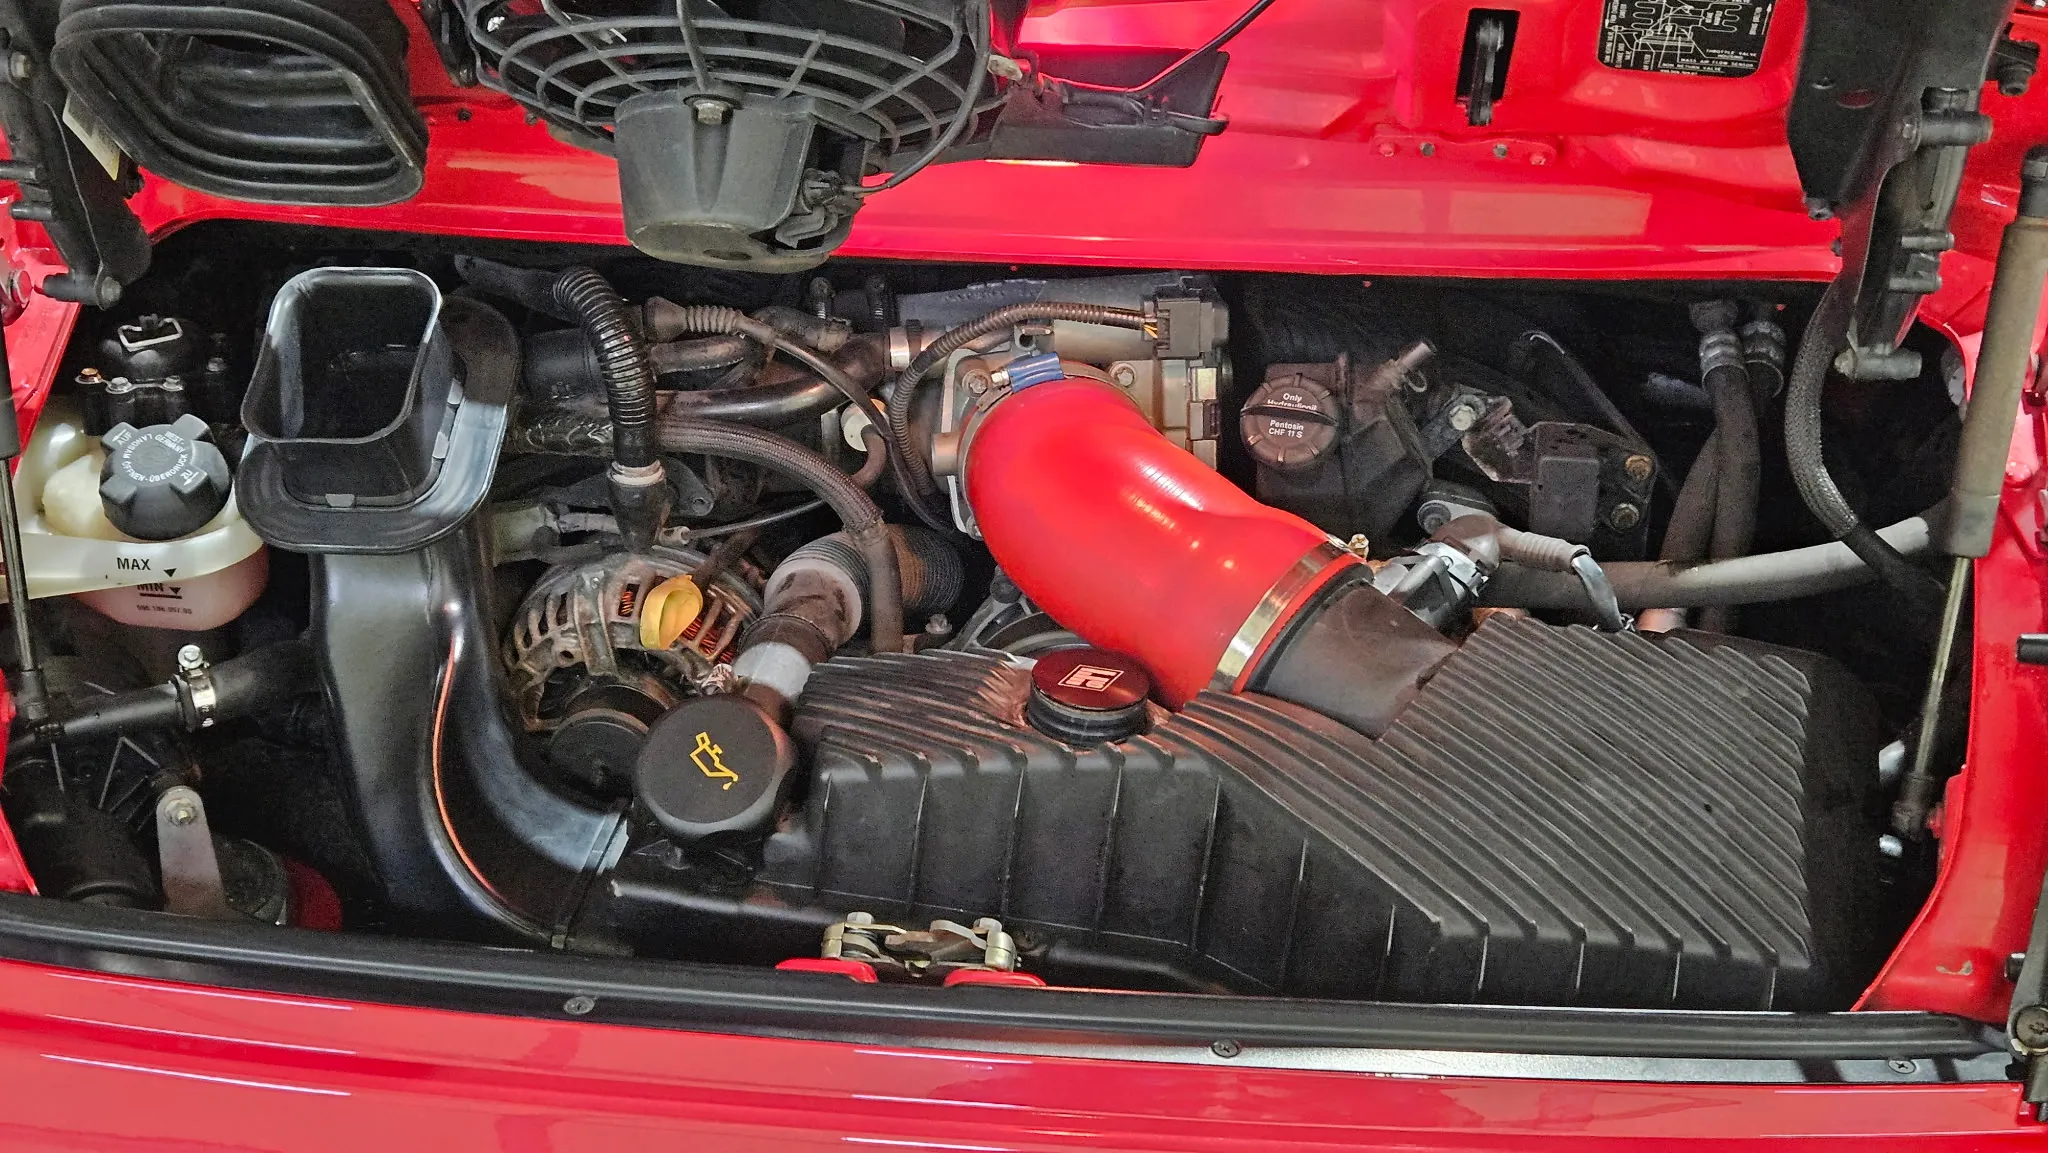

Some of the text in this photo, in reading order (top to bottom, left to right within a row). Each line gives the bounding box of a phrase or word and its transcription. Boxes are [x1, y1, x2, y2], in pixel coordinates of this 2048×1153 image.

[1283, 393, 1302, 403] Only
[1270, 419, 1304, 431] Pentosin
[117, 431, 132, 446] AUF
[1268, 427, 1286, 436] CHF
[1296, 431, 1303, 439] S
[122, 433, 153, 459] LANGSAM
[154, 433, 187, 454] GERMANY
[180, 469, 193, 480] ZU
[116, 557, 151, 571] MAX
[137, 583, 164, 592] MIN
